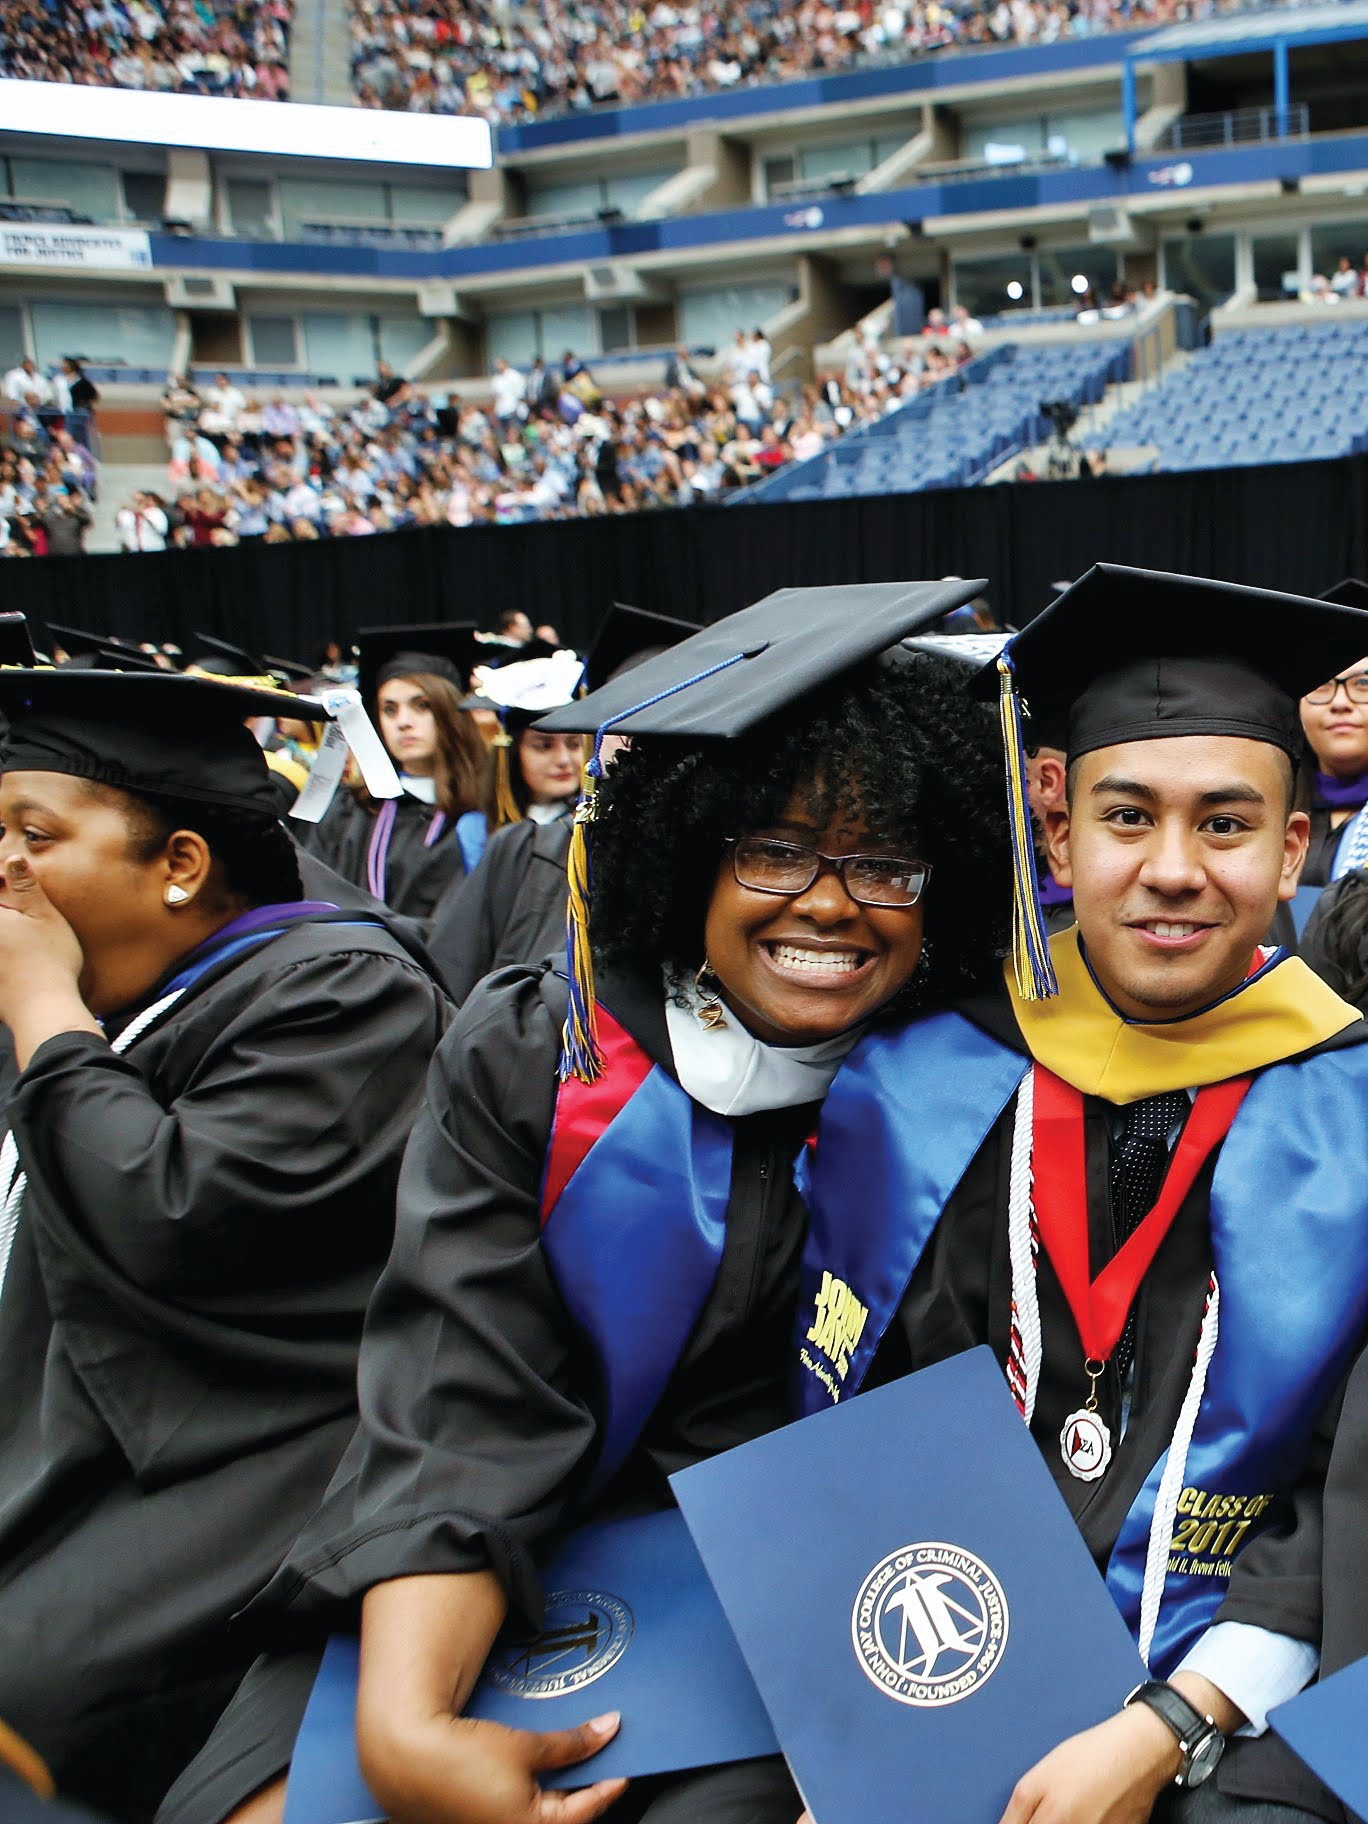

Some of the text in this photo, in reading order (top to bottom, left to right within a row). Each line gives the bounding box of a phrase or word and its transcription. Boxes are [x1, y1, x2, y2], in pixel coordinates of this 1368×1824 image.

[814, 1270, 869, 1346] JOHN
[806, 1307, 848, 1363] JAY
[1177, 1487, 1274, 1518] CLASS OF
[1170, 1518, 1252, 1556] 2017
[1189, 1558, 1215, 1576] Brown
[859, 1549, 1004, 1691] JOHN JAY COLLEGE OF CRIMINAL JUSTICE
[908, 1669, 978, 1700] FOUNDED
